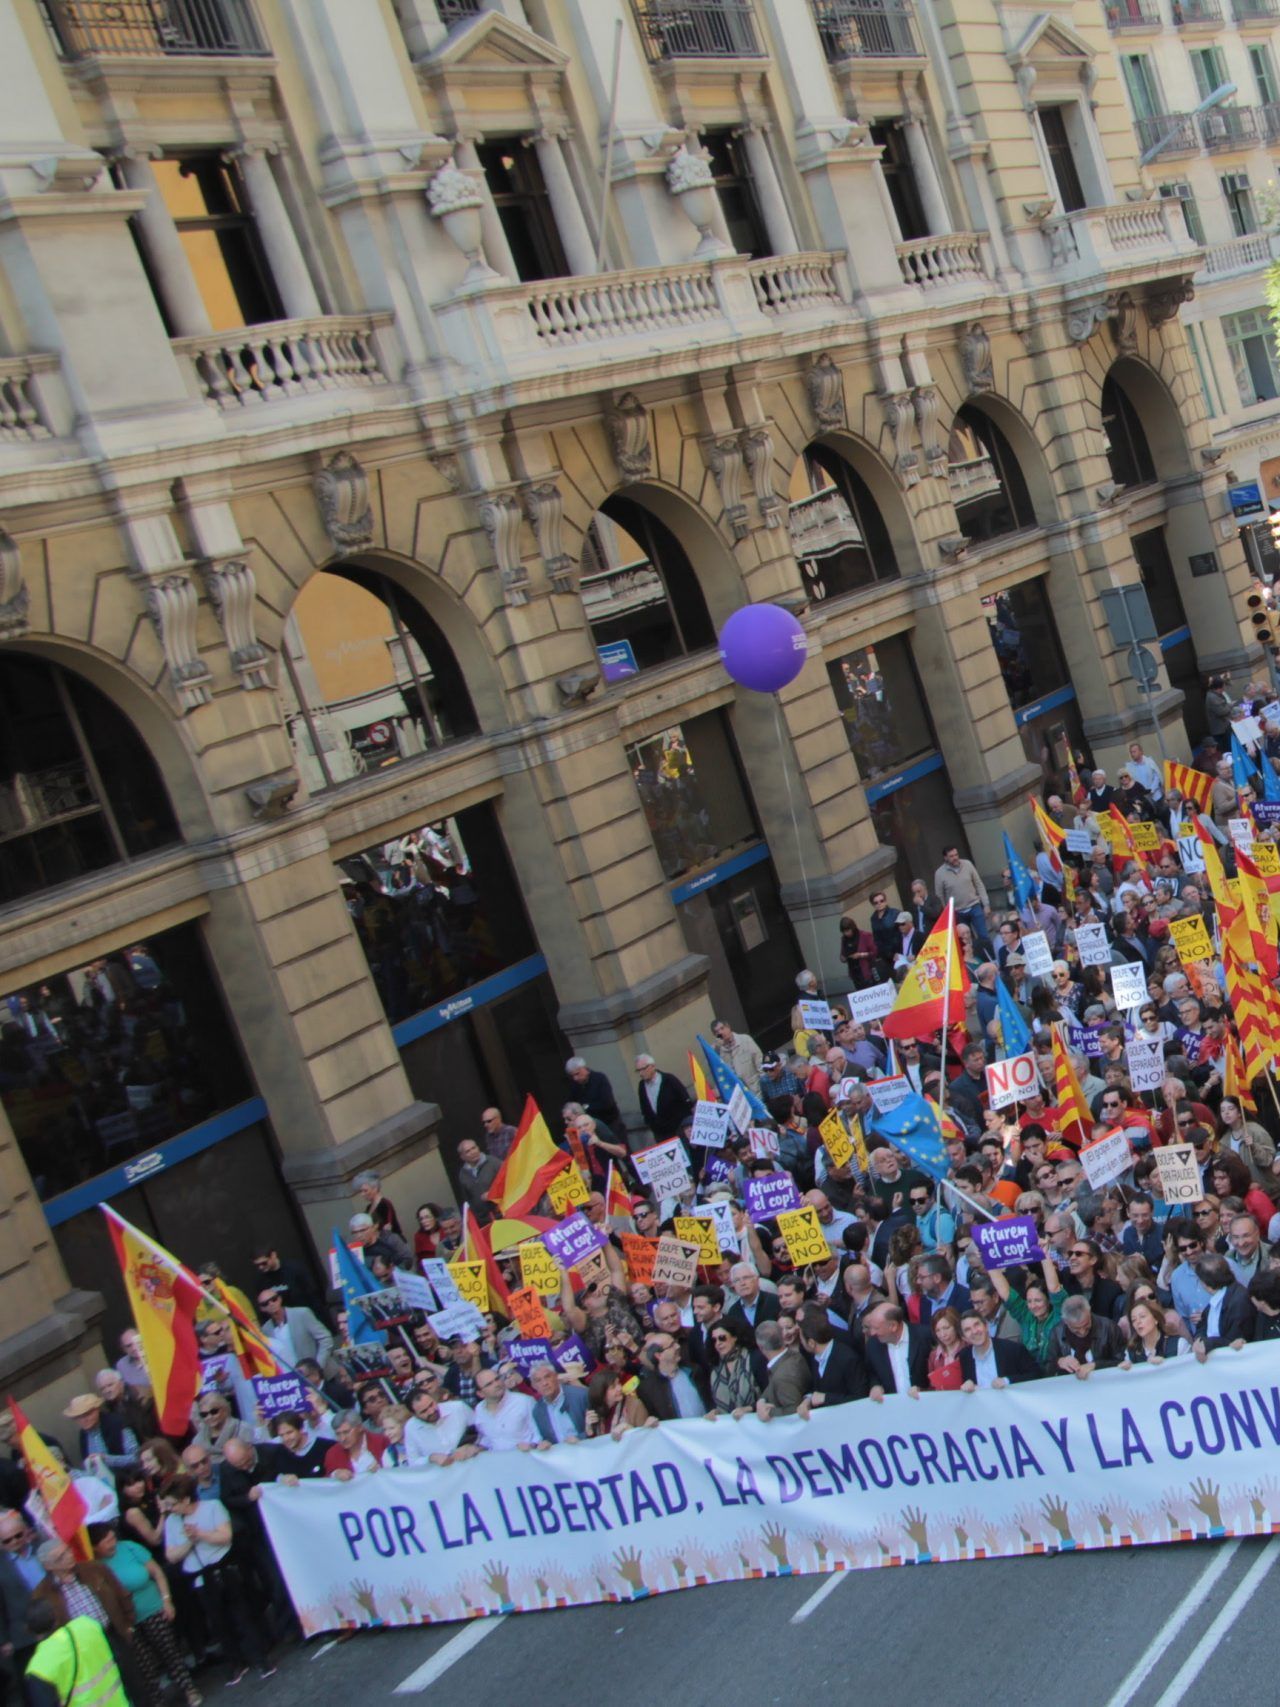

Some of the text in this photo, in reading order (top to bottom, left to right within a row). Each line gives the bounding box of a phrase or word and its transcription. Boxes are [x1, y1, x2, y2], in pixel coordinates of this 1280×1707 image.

[1171, 923, 1187, 935] COP
[1082, 950, 1110, 964] NO!
[1179, 943, 1210, 959] NO!
[1072, 1029, 1099, 1040] Ature
[1128, 1044, 1146, 1056] GOLPE
[987, 1056, 1035, 1091] NO
[1131, 1070, 1165, 1088] ¡NO!
[691, 1129, 725, 1144] ¡NO!
[750, 1130, 778, 1154] NO
[1156, 1152, 1176, 1167] GOLPE
[655, 1176, 689, 1197] ¡NO!
[749, 1177, 793, 1197] Aturem
[1163, 1184, 1200, 1204] ¡NO!
[754, 1191, 795, 1211] el cop!
[677, 1219, 696, 1230] COP
[780, 1215, 800, 1229] GOLPE
[549, 1218, 588, 1246] Aturem
[980, 1226, 1028, 1245] Aturem
[562, 1229, 595, 1255] el cop!
[661, 1241, 680, 1253] GOLPE
[988, 1241, 1031, 1259] el cop!
[790, 1242, 829, 1265] ¡NO!
[654, 1267, 692, 1285] ¡NO!
[457, 1280, 486, 1294] AJO,
[510, 1343, 548, 1358] Aturem
[258, 1378, 300, 1395] Aturem
[266, 1391, 302, 1409] el cop!
[339, 1505, 426, 1561] POR
[429, 1492, 488, 1550] LA
[494, 1460, 704, 1539] LIBERTAD,
[702, 1456, 762, 1507] LA
[764, 1422, 1045, 1505] DEMOCRACIA
[1041, 1418, 1078, 1475] Y
[1085, 1407, 1153, 1471] LA
